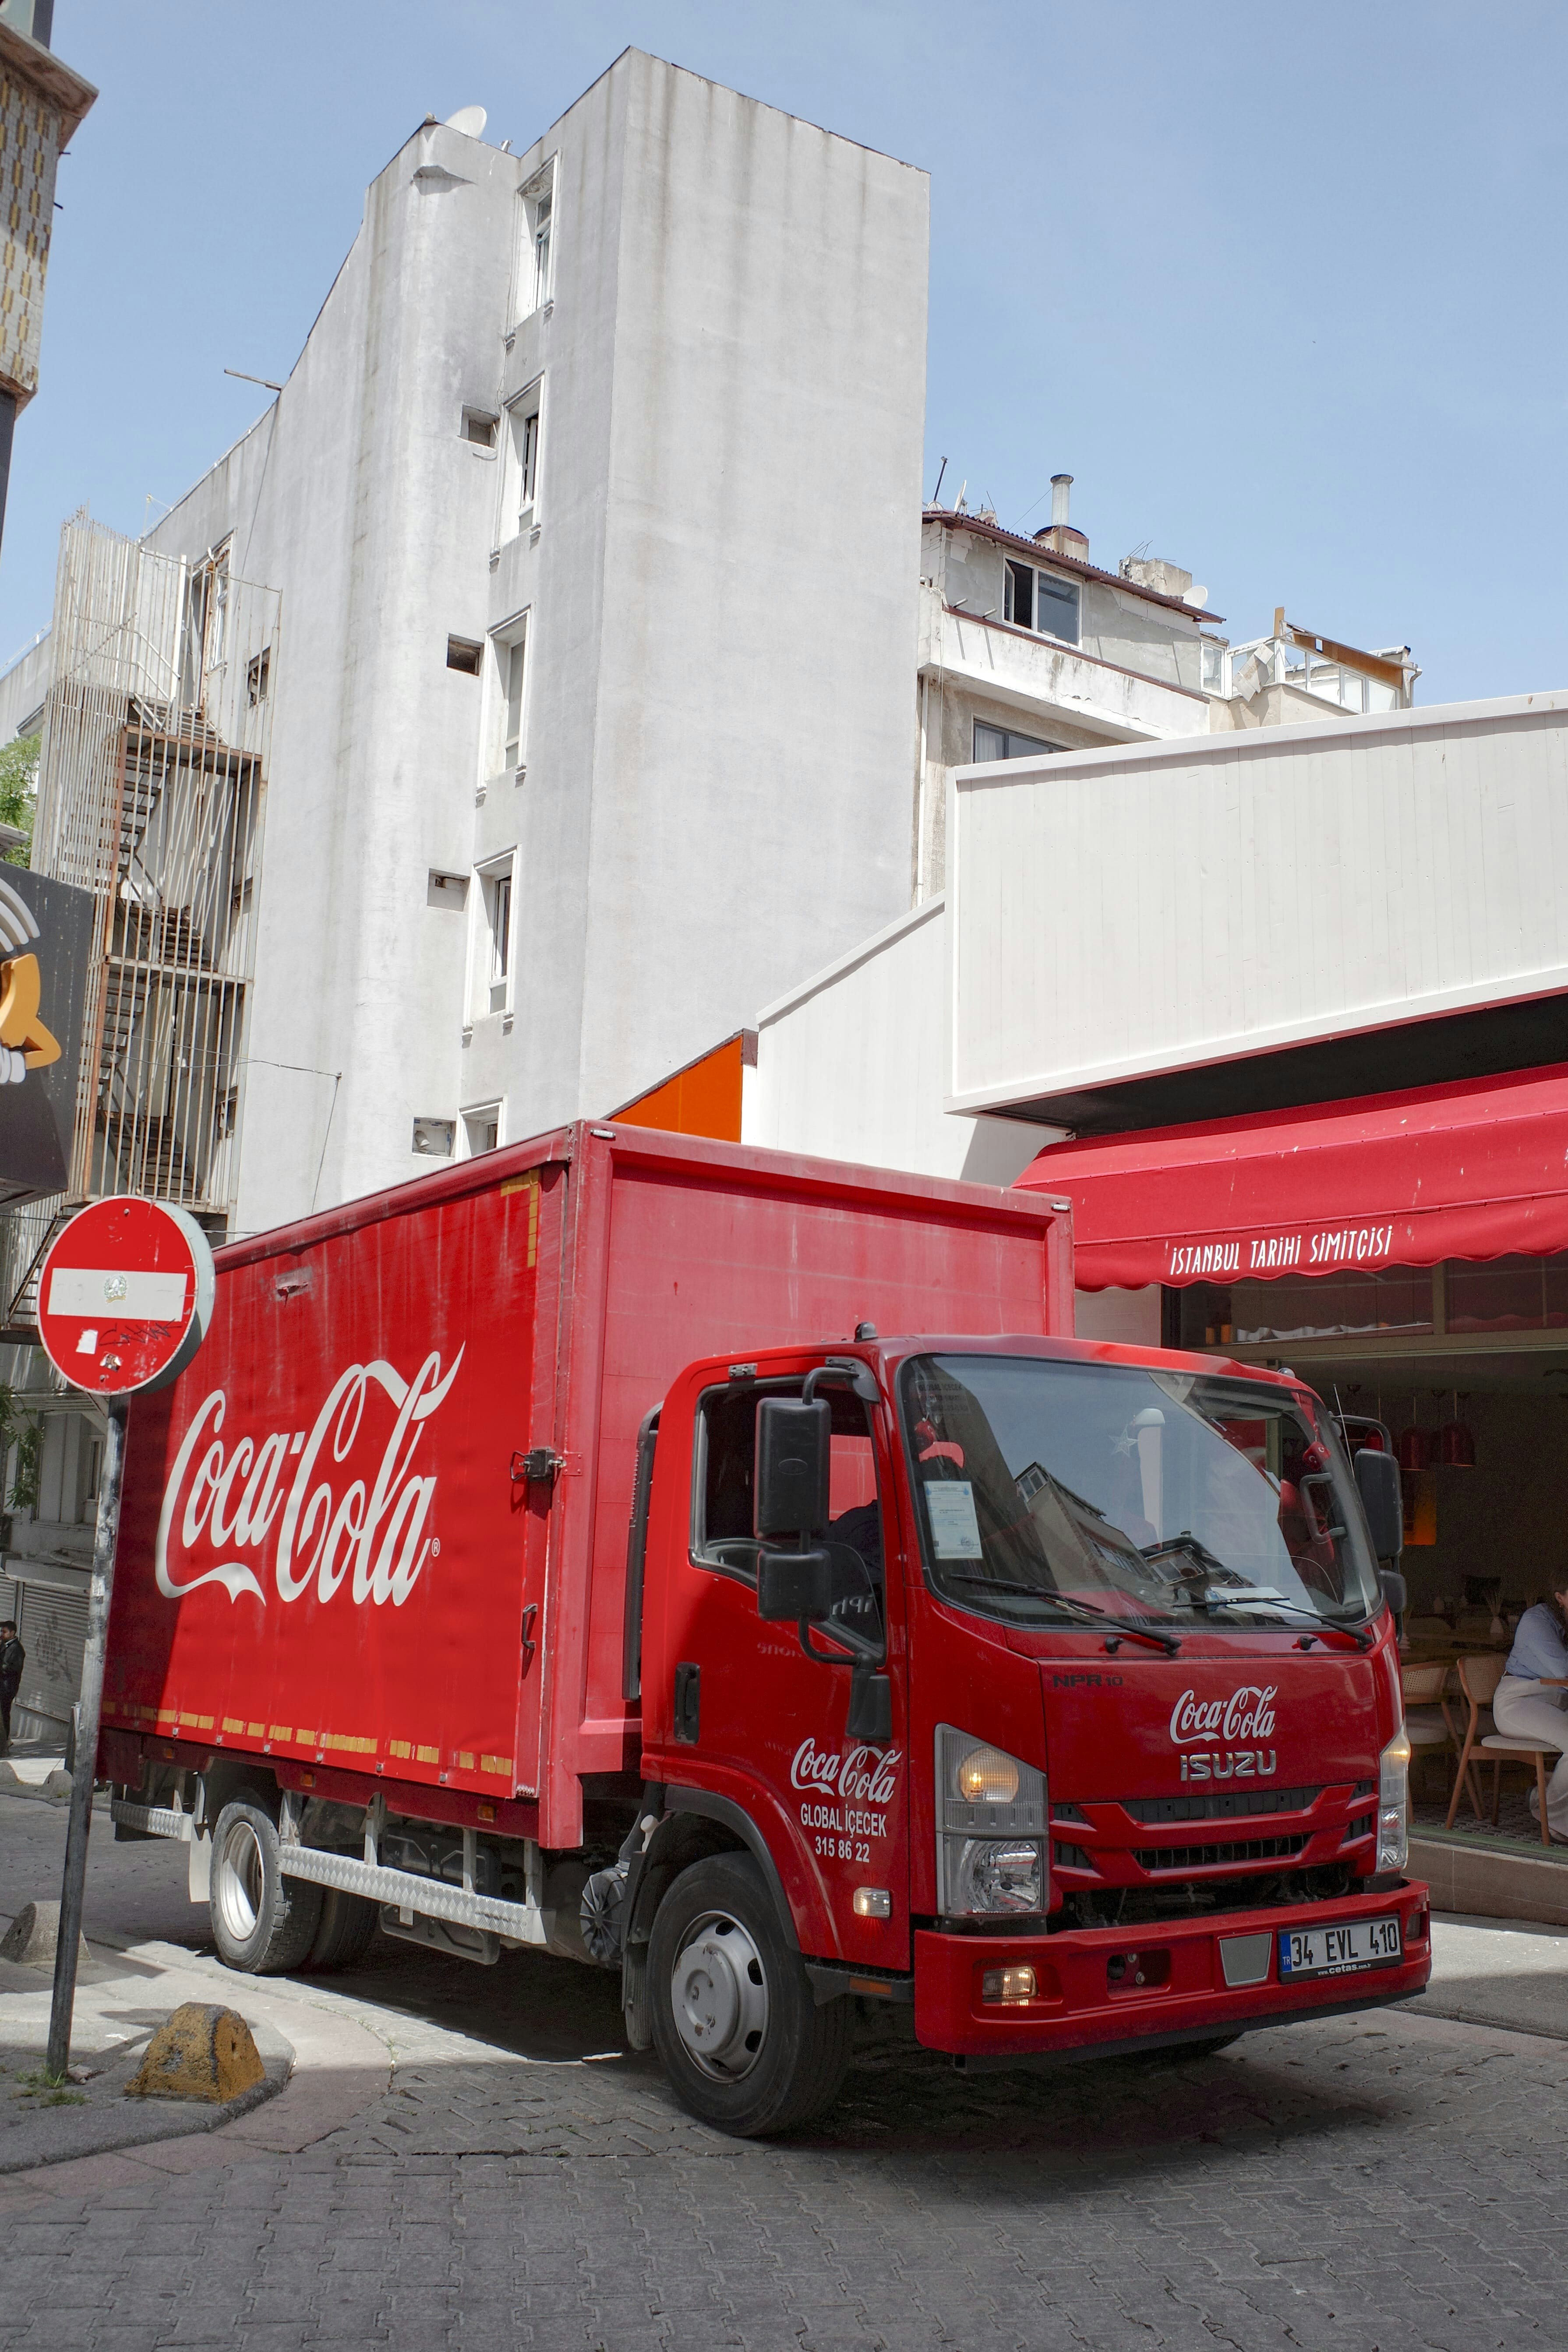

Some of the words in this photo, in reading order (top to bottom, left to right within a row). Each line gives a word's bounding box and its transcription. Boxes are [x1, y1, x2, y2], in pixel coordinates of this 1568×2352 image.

[1170, 1243, 1240, 1275] İSTANBUL
[1250, 1235, 1302, 1268] TARİHİ
[1309, 1225, 1393, 1263] SİMİTÇİSİ
[155, 1340, 466, 1607] Coca-Cola
[1053, 1674, 1102, 1688] NPR
[1106, 1677, 1123, 1687] 10
[1169, 1685, 1278, 1745] Coca-Cola
[1180, 1749, 1277, 1781] ISUZU
[801, 1803, 843, 1832] GLOBAL
[845, 1803, 887, 1839] İÇECEK
[815, 1836, 835, 1858] 315
[838, 1839, 852, 1860] 86
[855, 1842, 870, 1863] 22
[1282, 1956, 1291, 1966] TR
[1291, 1935, 1314, 1967] 34
[1325, 1928, 1359, 1963] EVL
[1370, 1922, 1398, 1955] 410
